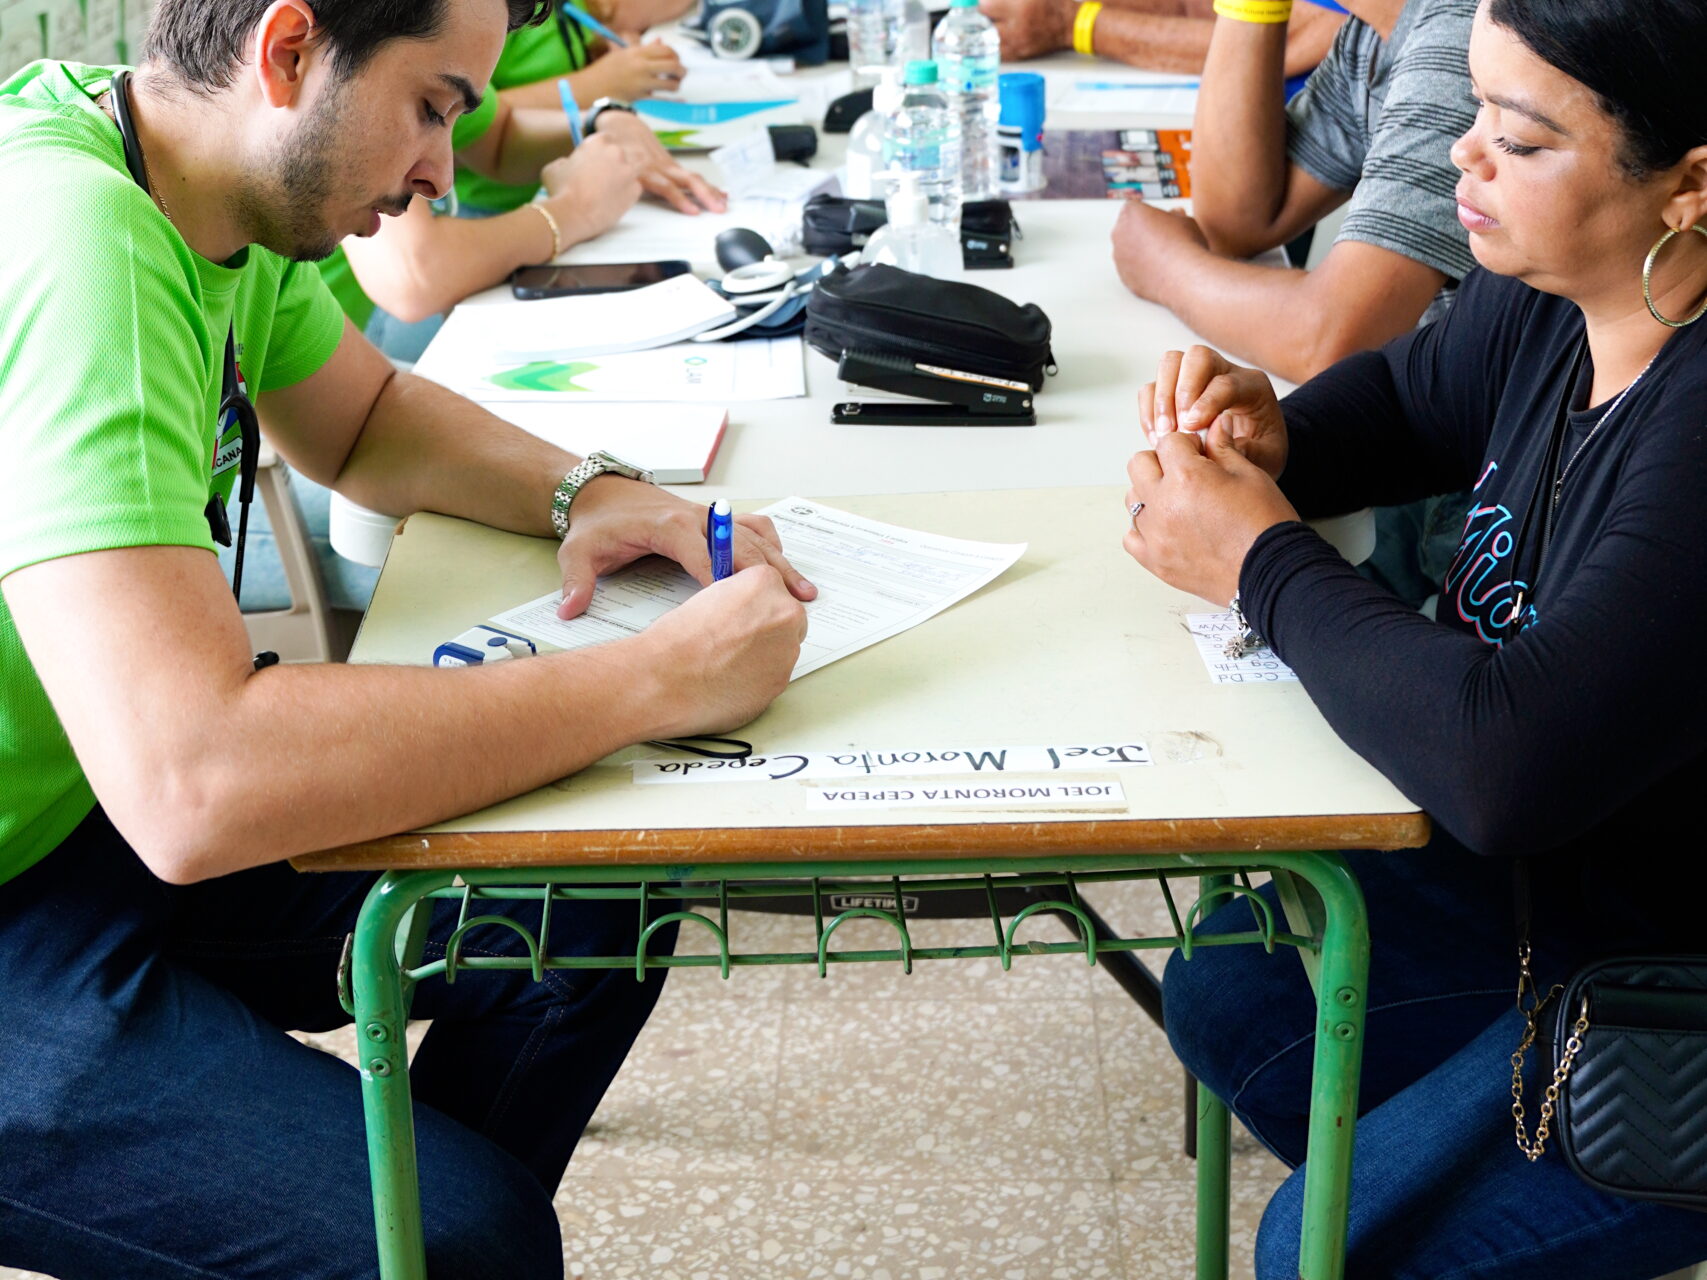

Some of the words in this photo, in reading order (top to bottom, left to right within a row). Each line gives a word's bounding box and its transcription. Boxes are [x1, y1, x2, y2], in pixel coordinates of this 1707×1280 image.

[653, 754, 809, 780] Cepeda
[825, 749, 1008, 774] Moronta
[1047, 745, 1149, 770] Joel
[822, 790, 915, 802] CEPEDA
[922, 787, 1051, 800] MORONTA
[1057, 785, 1112, 797] JOEL
